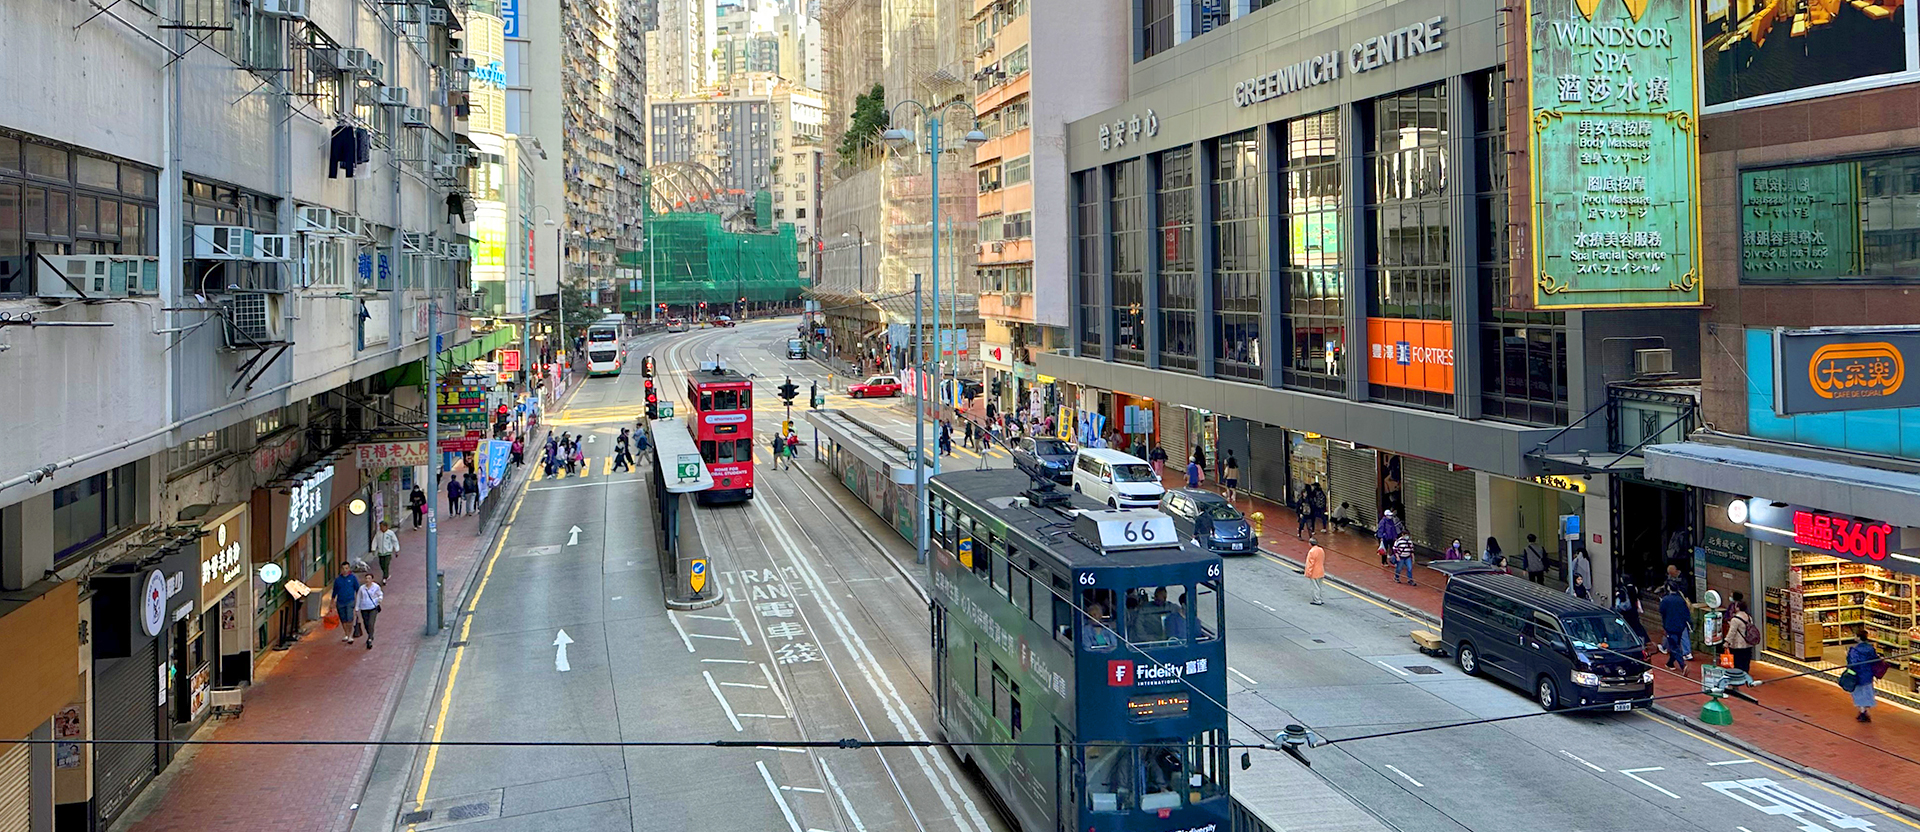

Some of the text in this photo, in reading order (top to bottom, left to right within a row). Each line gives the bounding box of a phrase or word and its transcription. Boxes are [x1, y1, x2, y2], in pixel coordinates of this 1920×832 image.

[1553, 22, 1670, 48] WINDSOR
[1233, 15, 1444, 107] GREENWICH CENTRE
[1593, 49, 1632, 73] SPA
[1098, 108, 1158, 152] 怡安中心
[1580, 120, 1652, 137] 男女賓按摩
[1580, 139, 1651, 152] Body Massage
[1581, 152, 1651, 165] 全身マッサージ
[1608, 195, 1651, 206] Massage
[1588, 207, 1648, 220] 足マッサージ
[1574, 231, 1663, 248] 水療美容服務
[1570, 250, 1667, 263] Spa Facial Service
[460, 391, 480, 399] GAME
[1833, 391, 1851, 399] CAFE
[1861, 389, 1883, 398] CORAL
[1124, 521, 1155, 543] 66
[1704, 545, 1747, 563] Fortress Tower
[720, 566, 799, 585] TRAM
[1079, 572, 1096, 585] 66
[1207, 564, 1220, 577] 66
[726, 583, 808, 602] LANE
[1030, 650, 1052, 689] Fidelity
[1136, 658, 1208, 680] Fidelity 富達
